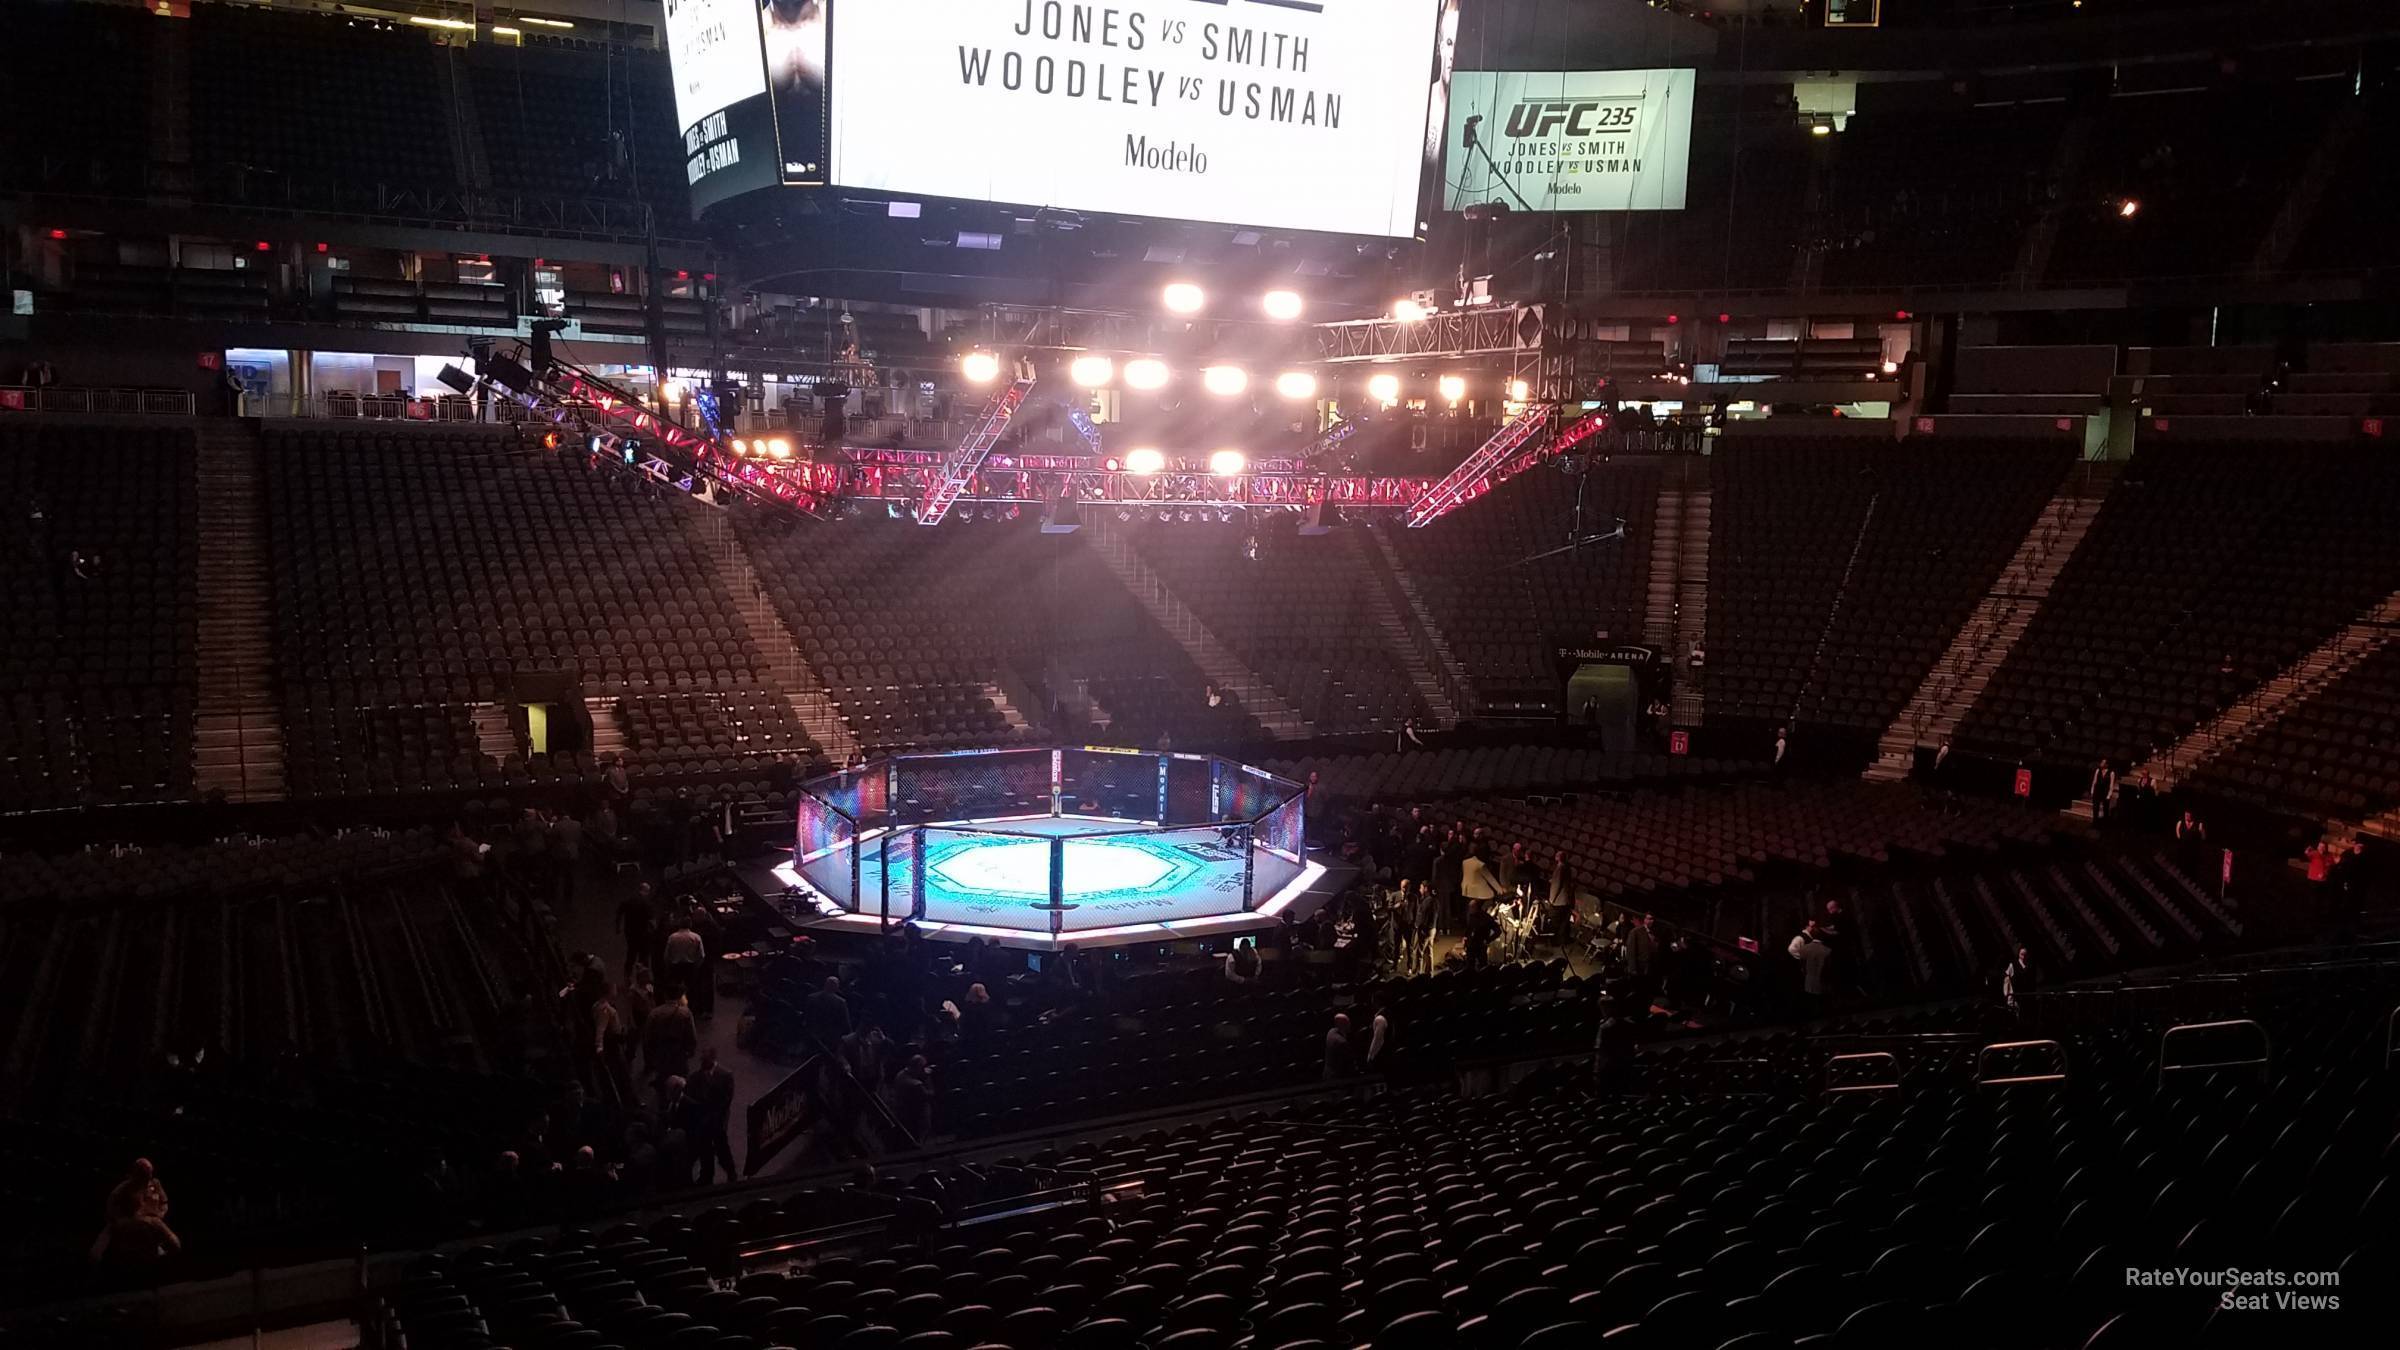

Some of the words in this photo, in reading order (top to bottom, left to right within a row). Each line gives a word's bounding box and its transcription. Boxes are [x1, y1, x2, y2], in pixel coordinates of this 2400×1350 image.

[1014, 0, 1145, 51] JONES
[1202, 23, 1310, 73] SMITH
[958, 45, 1165, 107] WOODLEY
[1218, 79, 1342, 129] USMAN
[702, 110, 728, 144] SMITH
[1505, 103, 1598, 137] UFC
[1597, 107, 1637, 127] 235
[709, 137, 740, 172] USMAN
[1124, 133, 1208, 174] Modelo
[1508, 143, 1557, 157] JONES
[1578, 141, 1625, 155] SMITH
[1489, 159, 1565, 175] WOODLEY
[1585, 159, 1642, 173] USMAN
[1548, 183, 1581, 195] Modelo
[1610, 652, 1645, 661] ARENA
[1158, 766, 1167, 820] Modelo
